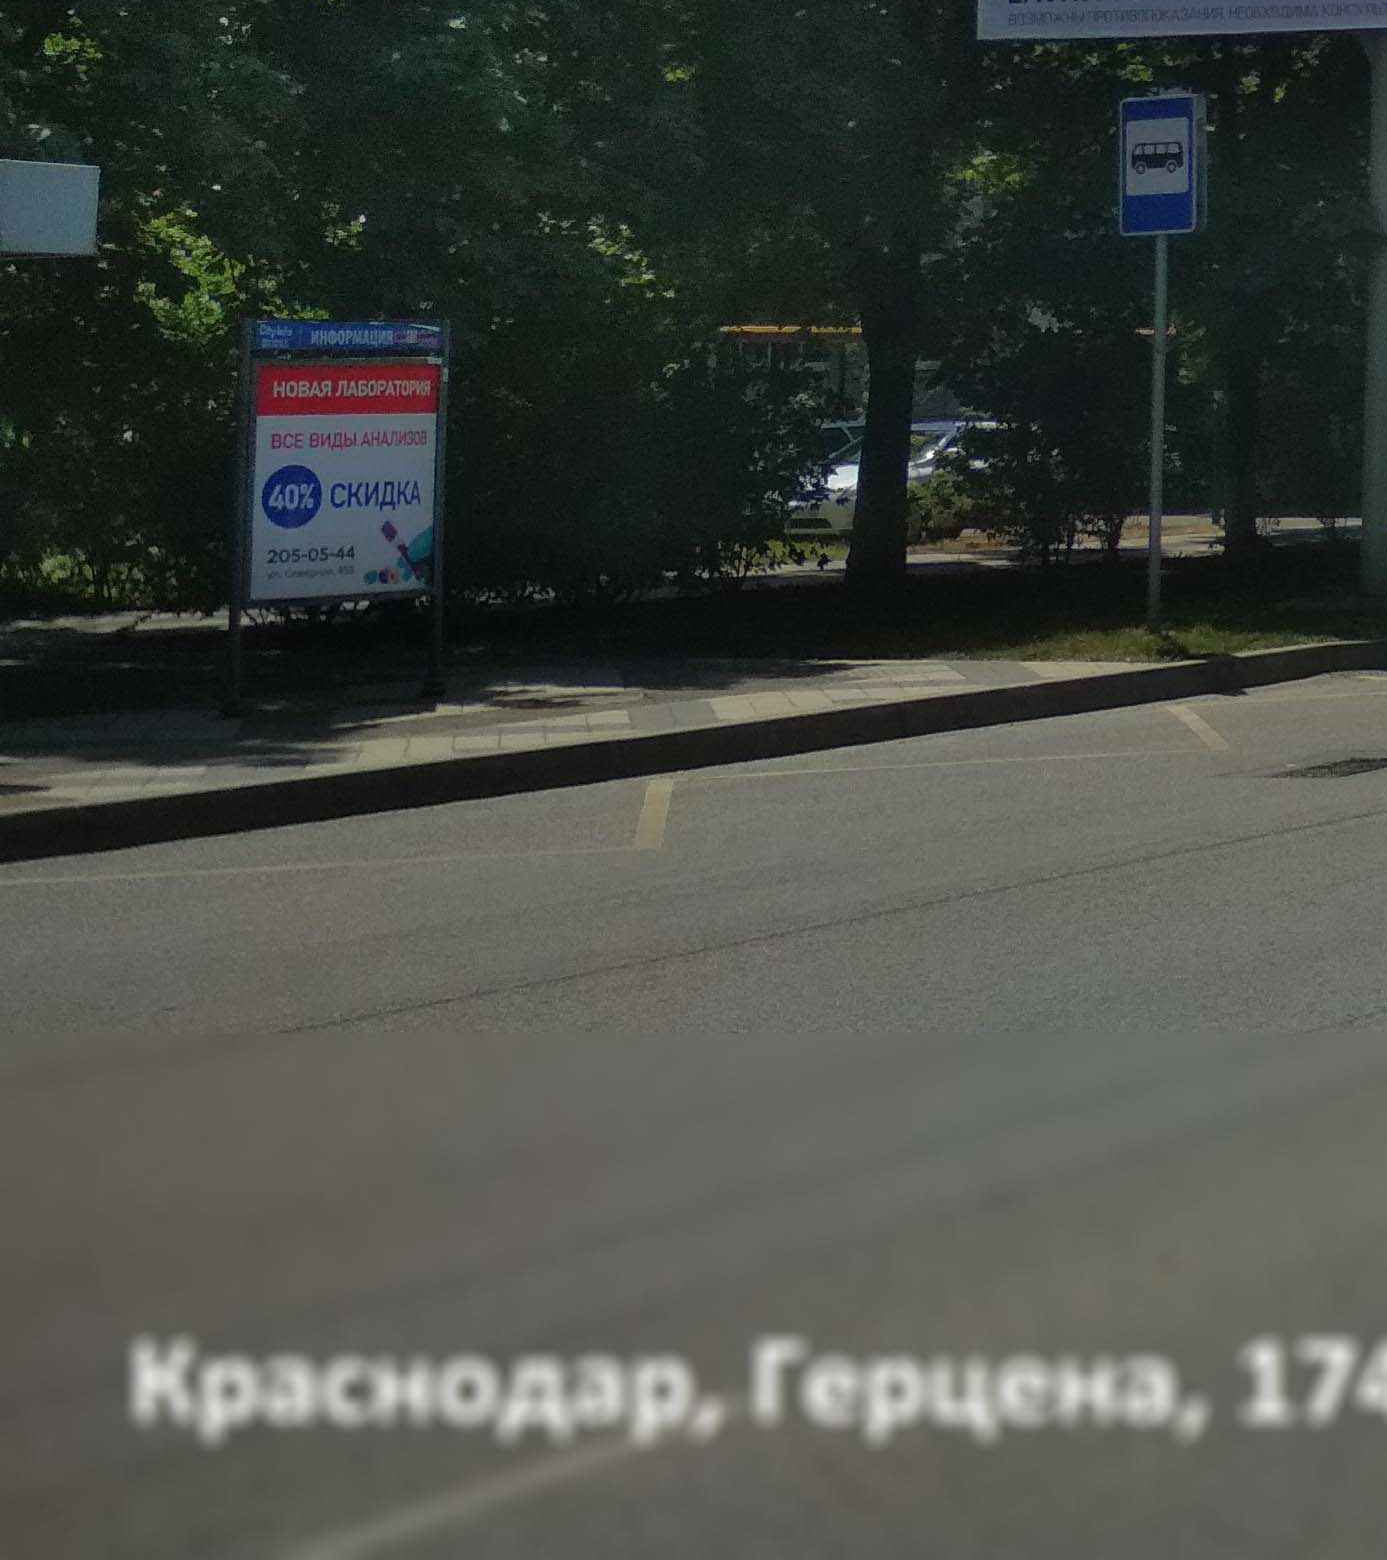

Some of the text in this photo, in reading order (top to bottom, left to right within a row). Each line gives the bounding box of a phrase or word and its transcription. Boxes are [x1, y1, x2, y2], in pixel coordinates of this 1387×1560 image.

[272, 379, 432, 398] НОВАЯ ЛАБОРАТОРИЯ
[271, 430, 428, 451] ВСЕ ВИДЫ АНАЛИЗОВ
[267, 481, 421, 511] 40% СКИДКА
[266, 545, 356, 565] 205-05-44
